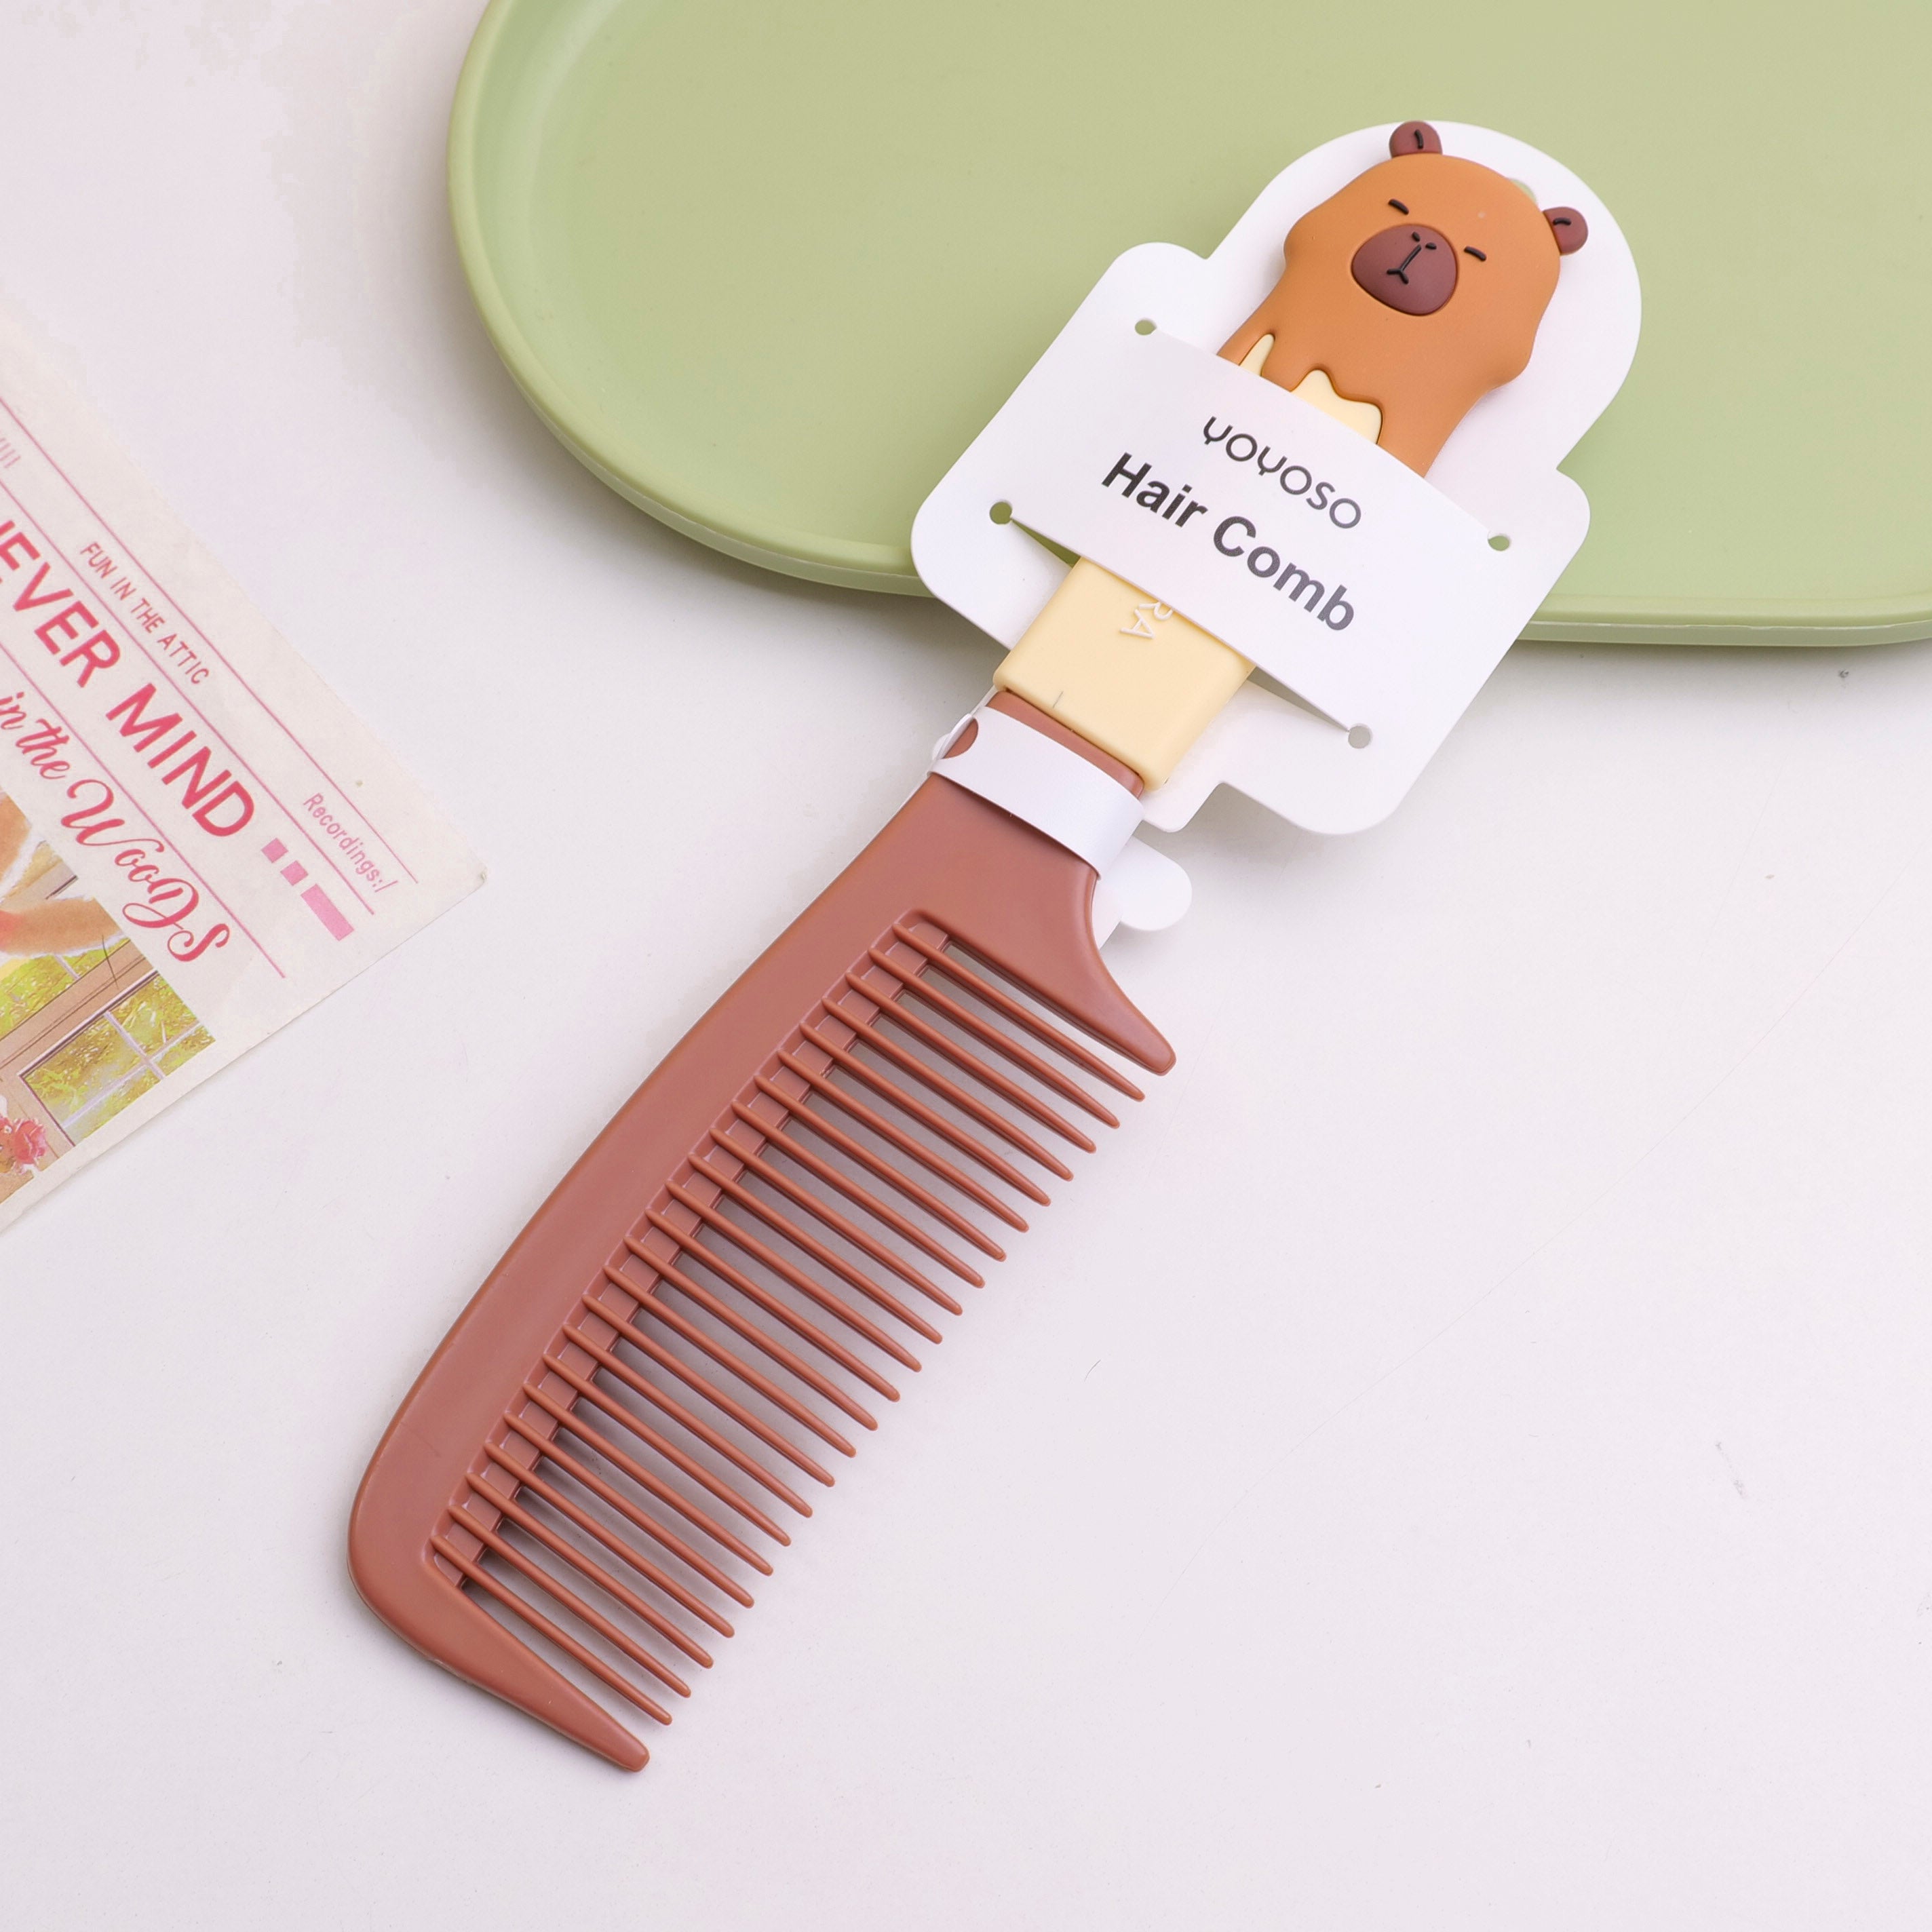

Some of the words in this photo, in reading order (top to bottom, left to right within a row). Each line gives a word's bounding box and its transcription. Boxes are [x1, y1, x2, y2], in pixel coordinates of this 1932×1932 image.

[79, 541, 117, 579] FUN
[109, 577, 136, 600] IN
[130, 597, 166, 634] THE
[157, 633, 210, 684] ATTIC
[1101, 452, 1208, 528] Hair
[1213, 516, 1355, 632] Comb
[0, 520, 121, 688] EVER
[105, 683, 255, 837] MIND
[16, 718, 70, 779] the
